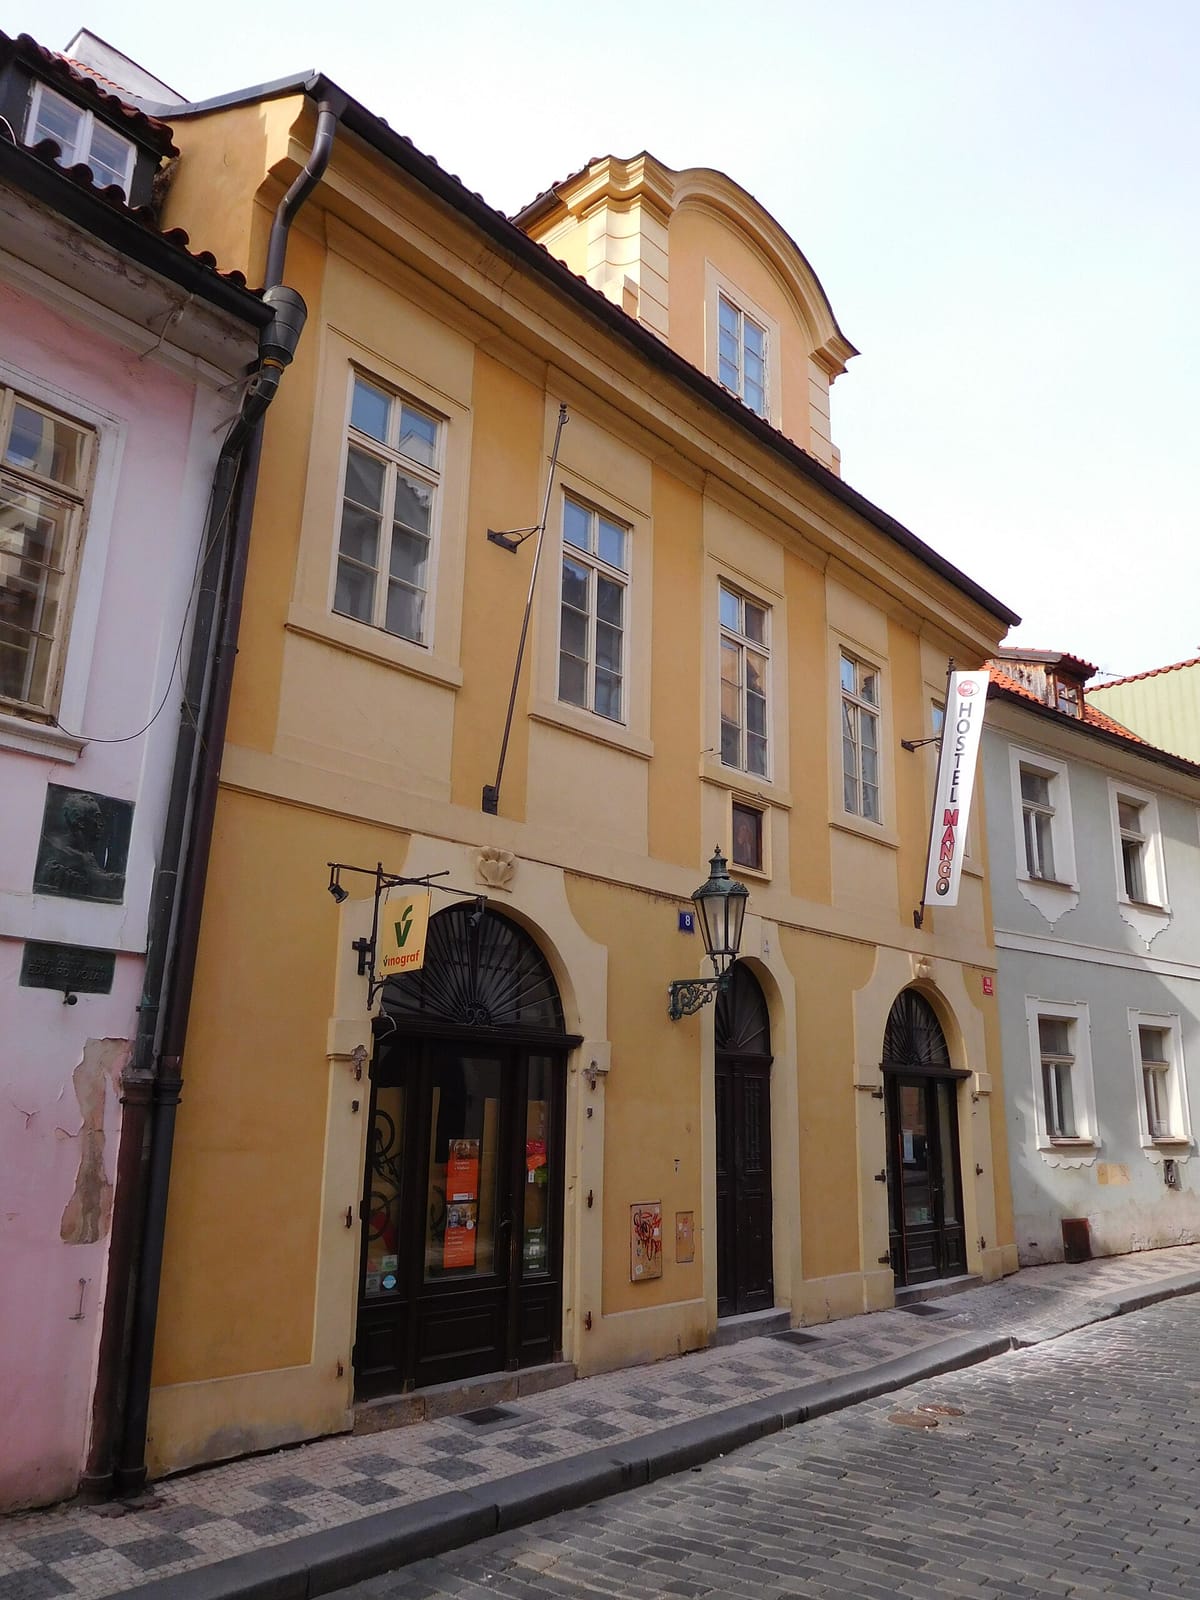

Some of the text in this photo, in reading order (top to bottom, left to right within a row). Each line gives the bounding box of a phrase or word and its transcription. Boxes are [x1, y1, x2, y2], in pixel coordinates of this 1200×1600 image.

[935, 702, 972, 896] HOSTEL MANGO
[685, 915, 691, 926] 8
